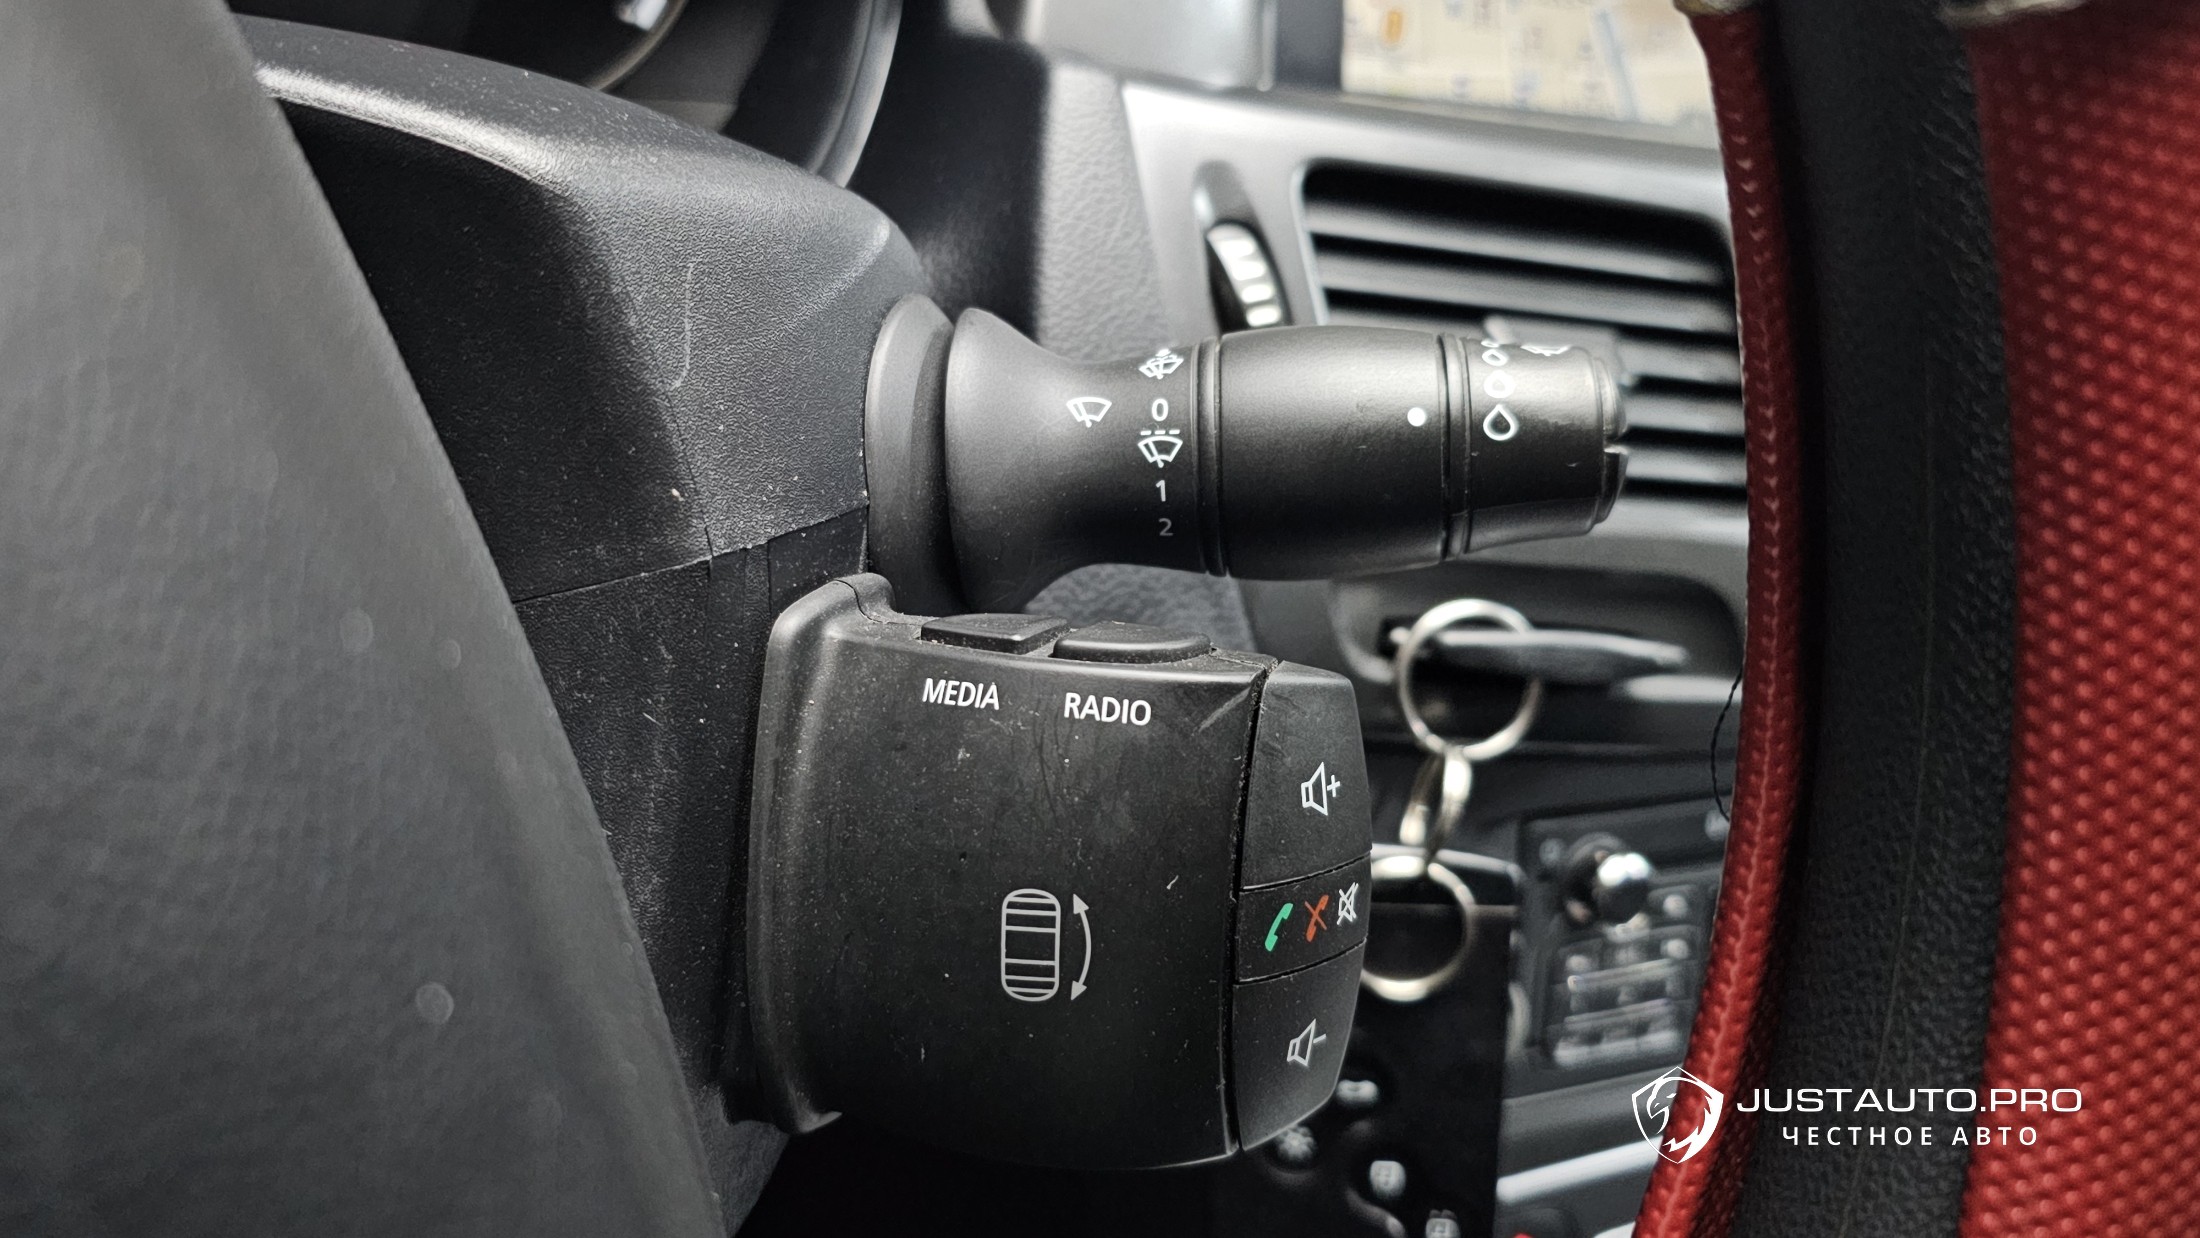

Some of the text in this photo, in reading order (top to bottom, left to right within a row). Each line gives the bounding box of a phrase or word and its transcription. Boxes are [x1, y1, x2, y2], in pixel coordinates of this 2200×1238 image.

[1151, 398, 1169, 422] 0
[1155, 479, 1167, 502] 1
[1159, 517, 1173, 536] 2
[922, 677, 1000, 711] MEDIA
[1063, 692, 1152, 726] RADIO
